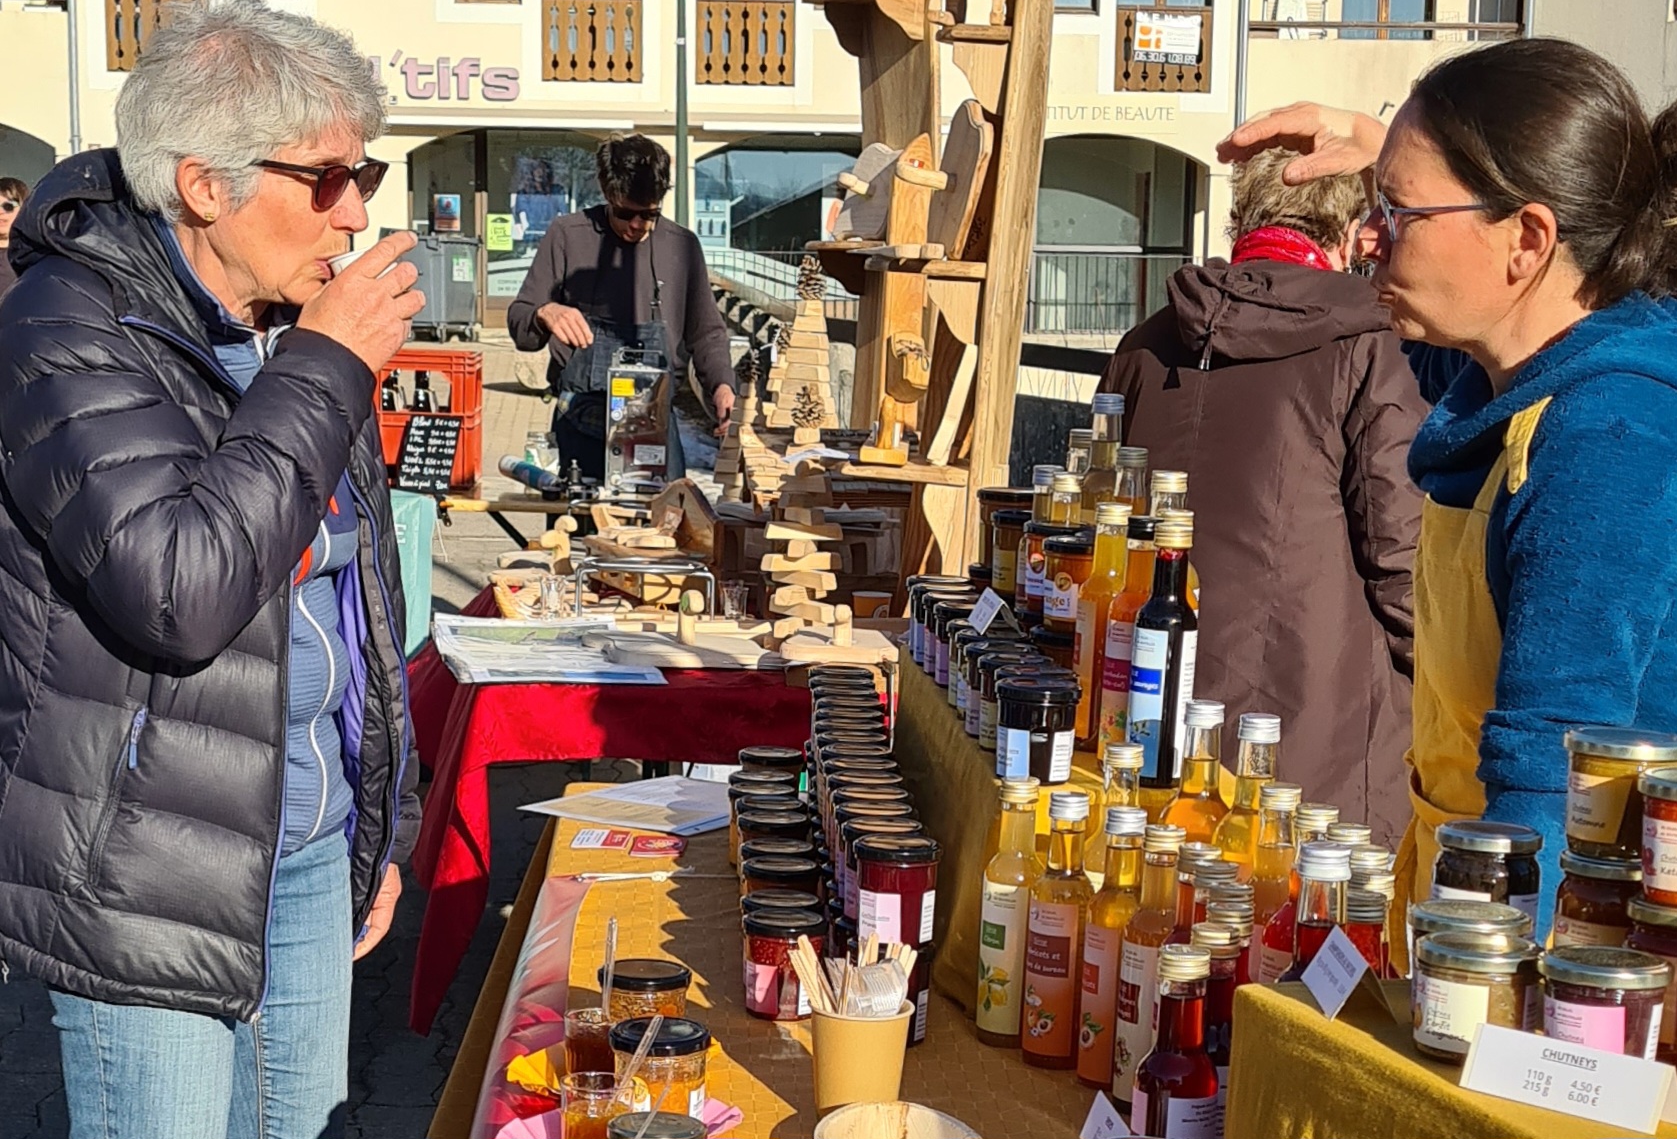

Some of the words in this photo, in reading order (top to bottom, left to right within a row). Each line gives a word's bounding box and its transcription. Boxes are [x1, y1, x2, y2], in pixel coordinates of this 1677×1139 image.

[1092, 106, 1111, 121] DE
[1115, 106, 1175, 121] BEAUTE
[1542, 1048, 1598, 1070] CHUTNEYS
[1522, 1080, 1541, 1093] 215
[1542, 1086, 1550, 1097] g
[1567, 1090, 1589, 1104] 6.00
[1591, 1096, 1599, 1106] €
[1527, 1069, 1544, 1081] 110
[1545, 1075, 1553, 1086] g
[1570, 1080, 1593, 1093] 4.50
[1594, 1085, 1602, 1095] €
